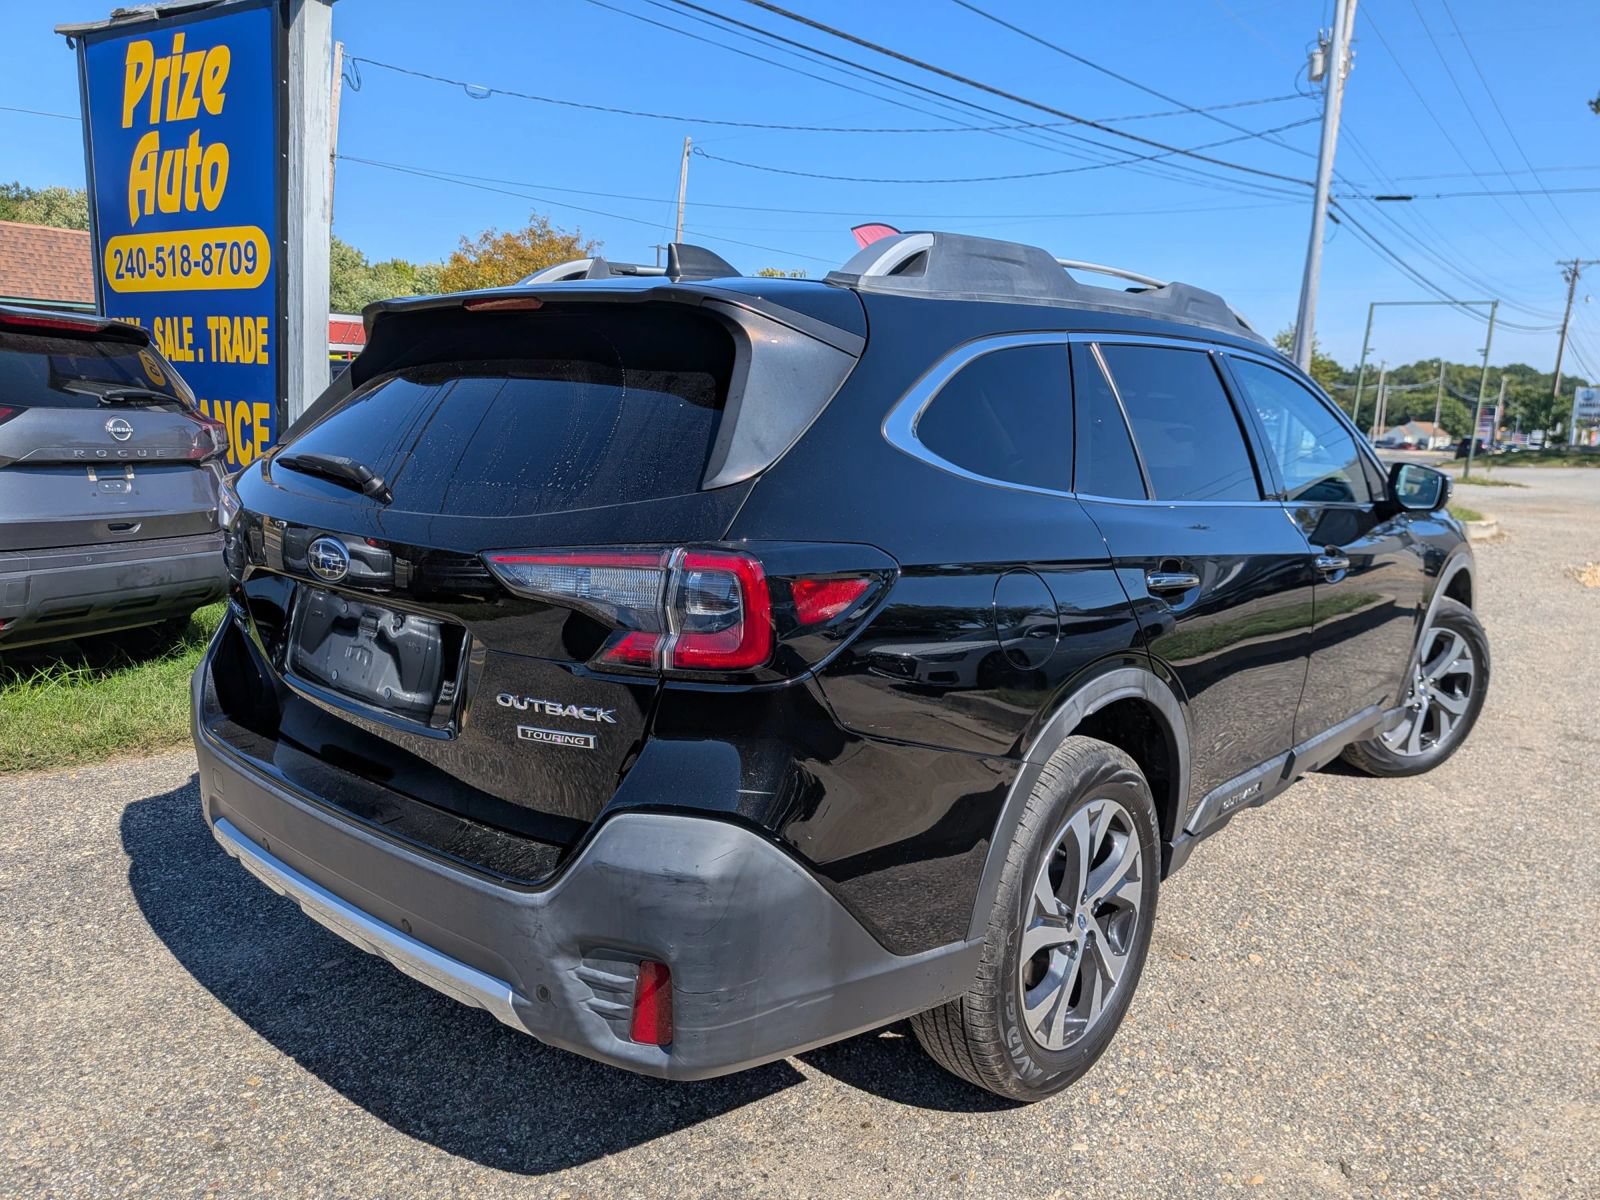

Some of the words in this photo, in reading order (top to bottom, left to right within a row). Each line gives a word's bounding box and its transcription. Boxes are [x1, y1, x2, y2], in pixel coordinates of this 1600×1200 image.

[121, 32, 231, 129] Prize
[128, 129, 230, 227] Auto
[113, 240, 258, 281] 240-518-8709
[153, 316, 195, 363] SALE
[207, 316, 269, 365] TRADE
[73, 449, 166, 458] ROGUE
[496, 693, 617, 724] OUTBACK
[525, 730, 584, 745] TOURING
